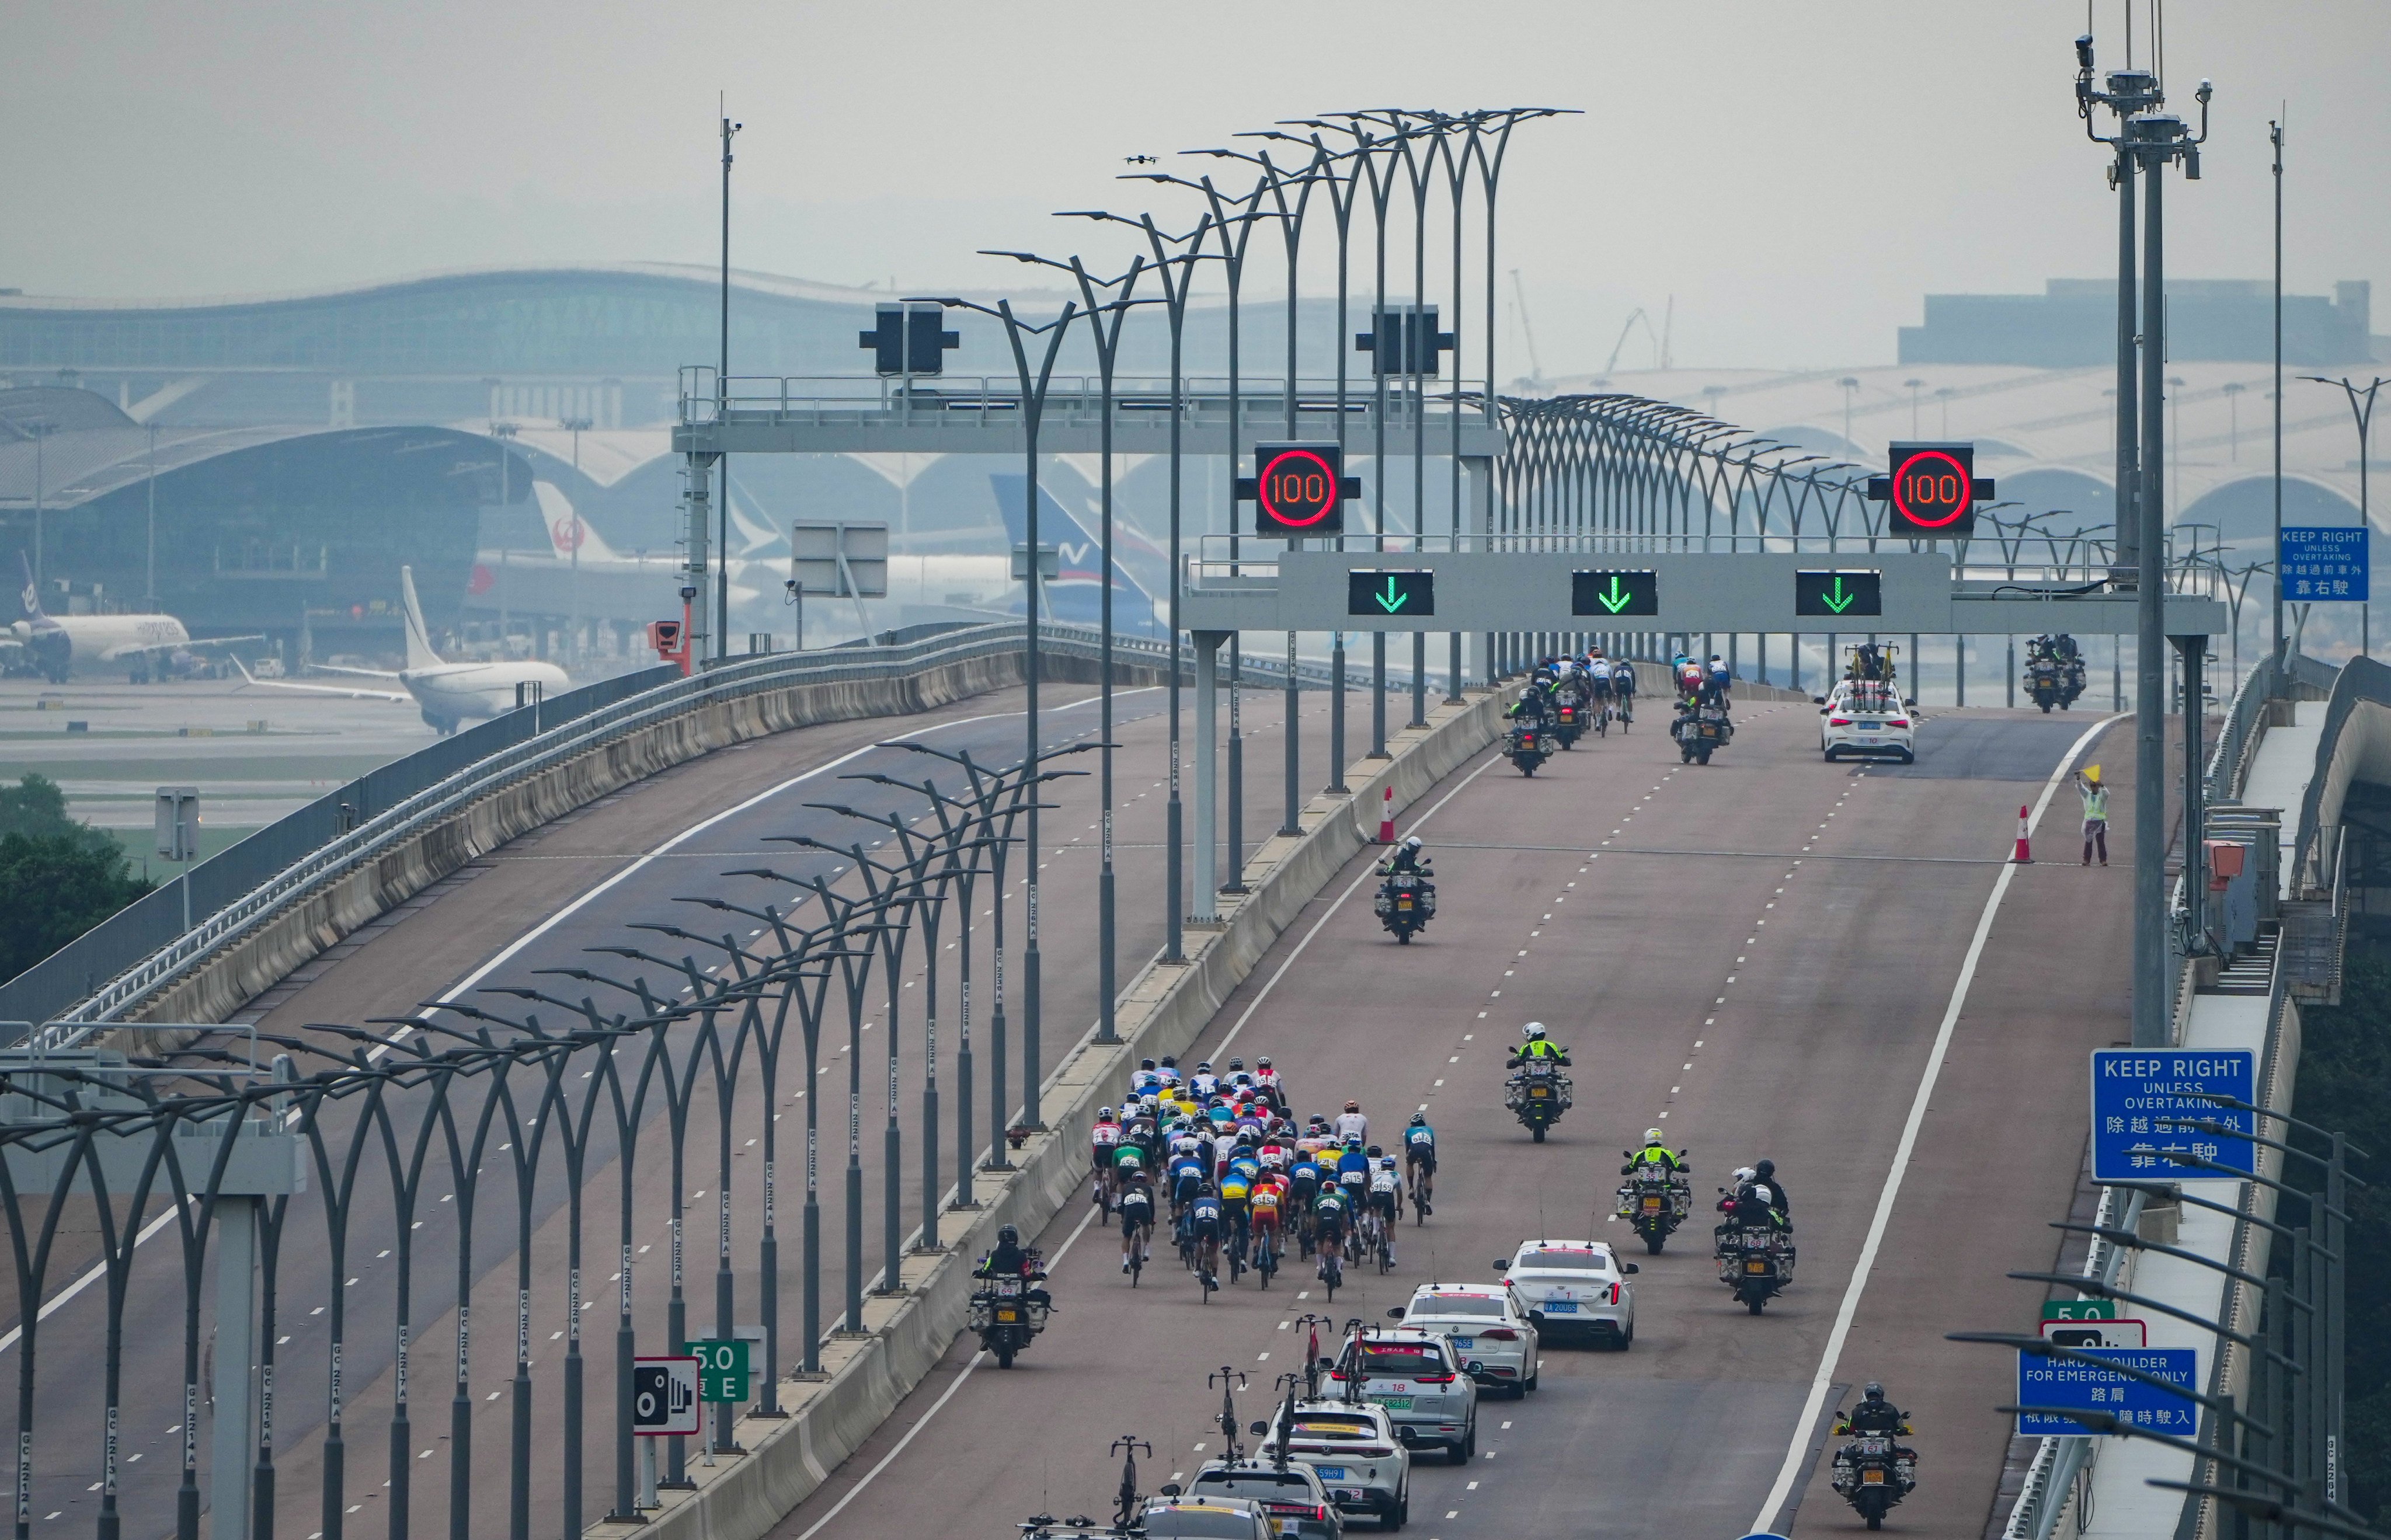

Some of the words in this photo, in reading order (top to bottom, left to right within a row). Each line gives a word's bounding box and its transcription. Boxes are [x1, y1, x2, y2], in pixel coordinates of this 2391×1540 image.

[1272, 474, 1324, 503] 100
[1906, 475, 1957, 503] 100
[2283, 532, 2315, 542] KEEP
[2323, 532, 2361, 542] RIGHT
[2296, 580, 2348, 594] 靠右駛
[1234, 682, 1238, 693] GC
[1106, 811, 1111, 824] GC
[1031, 887, 1035, 898] GC
[997, 950, 1002, 963] GC
[964, 985, 969, 997] GC
[892, 1060, 897, 1073] GC
[2105, 1060, 2161, 1076] KEEP
[2174, 1060, 2241, 1076] RIGHT
[2144, 1082, 2203, 1093] UNLESS
[852, 1096, 858, 1109] GC
[810, 1131, 815, 1145] GC
[767, 1164, 772, 1178] GC
[1247, 1168, 1255, 1177] 56
[723, 1194, 729, 1208] GC
[675, 1222, 680, 1236] GC
[625, 1248, 630, 1262] GC
[572, 1273, 578, 1288] GC
[521, 1293, 527, 1309] GC
[461, 1310, 468, 1326] GC
[401, 1329, 406, 1347] GC
[1453, 1339, 1471, 1347] 965E
[334, 1346, 341, 1364] GC
[692, 1346, 733, 1370] 5.0
[2091, 1357, 2167, 1368] OULDER
[264, 1368, 271, 1386] GC
[2027, 1371, 2053, 1381] FOR
[2058, 1371, 2143, 1381] EMERGENC
[2151, 1371, 2188, 1382] ONLY
[723, 1378, 736, 1397] E
[1392, 1384, 1405, 1393] 18
[188, 1388, 196, 1407] GC
[2091, 1388, 2124, 1402] 路肩
[109, 1410, 116, 1430] GC
[333, 1409, 340, 1417] A
[263, 1433, 270, 1441] A
[22, 1435, 30, 1455] GC
[2328, 1441, 2334, 1457] GC
[108, 1436, 116, 1474] 2213
[188, 1454, 195, 1463] A
[1319, 1469, 1343, 1479] 59H91
[21, 1462, 29, 1501] 2212
[107, 1479, 115, 1489] A
[20, 1506, 28, 1515] A
